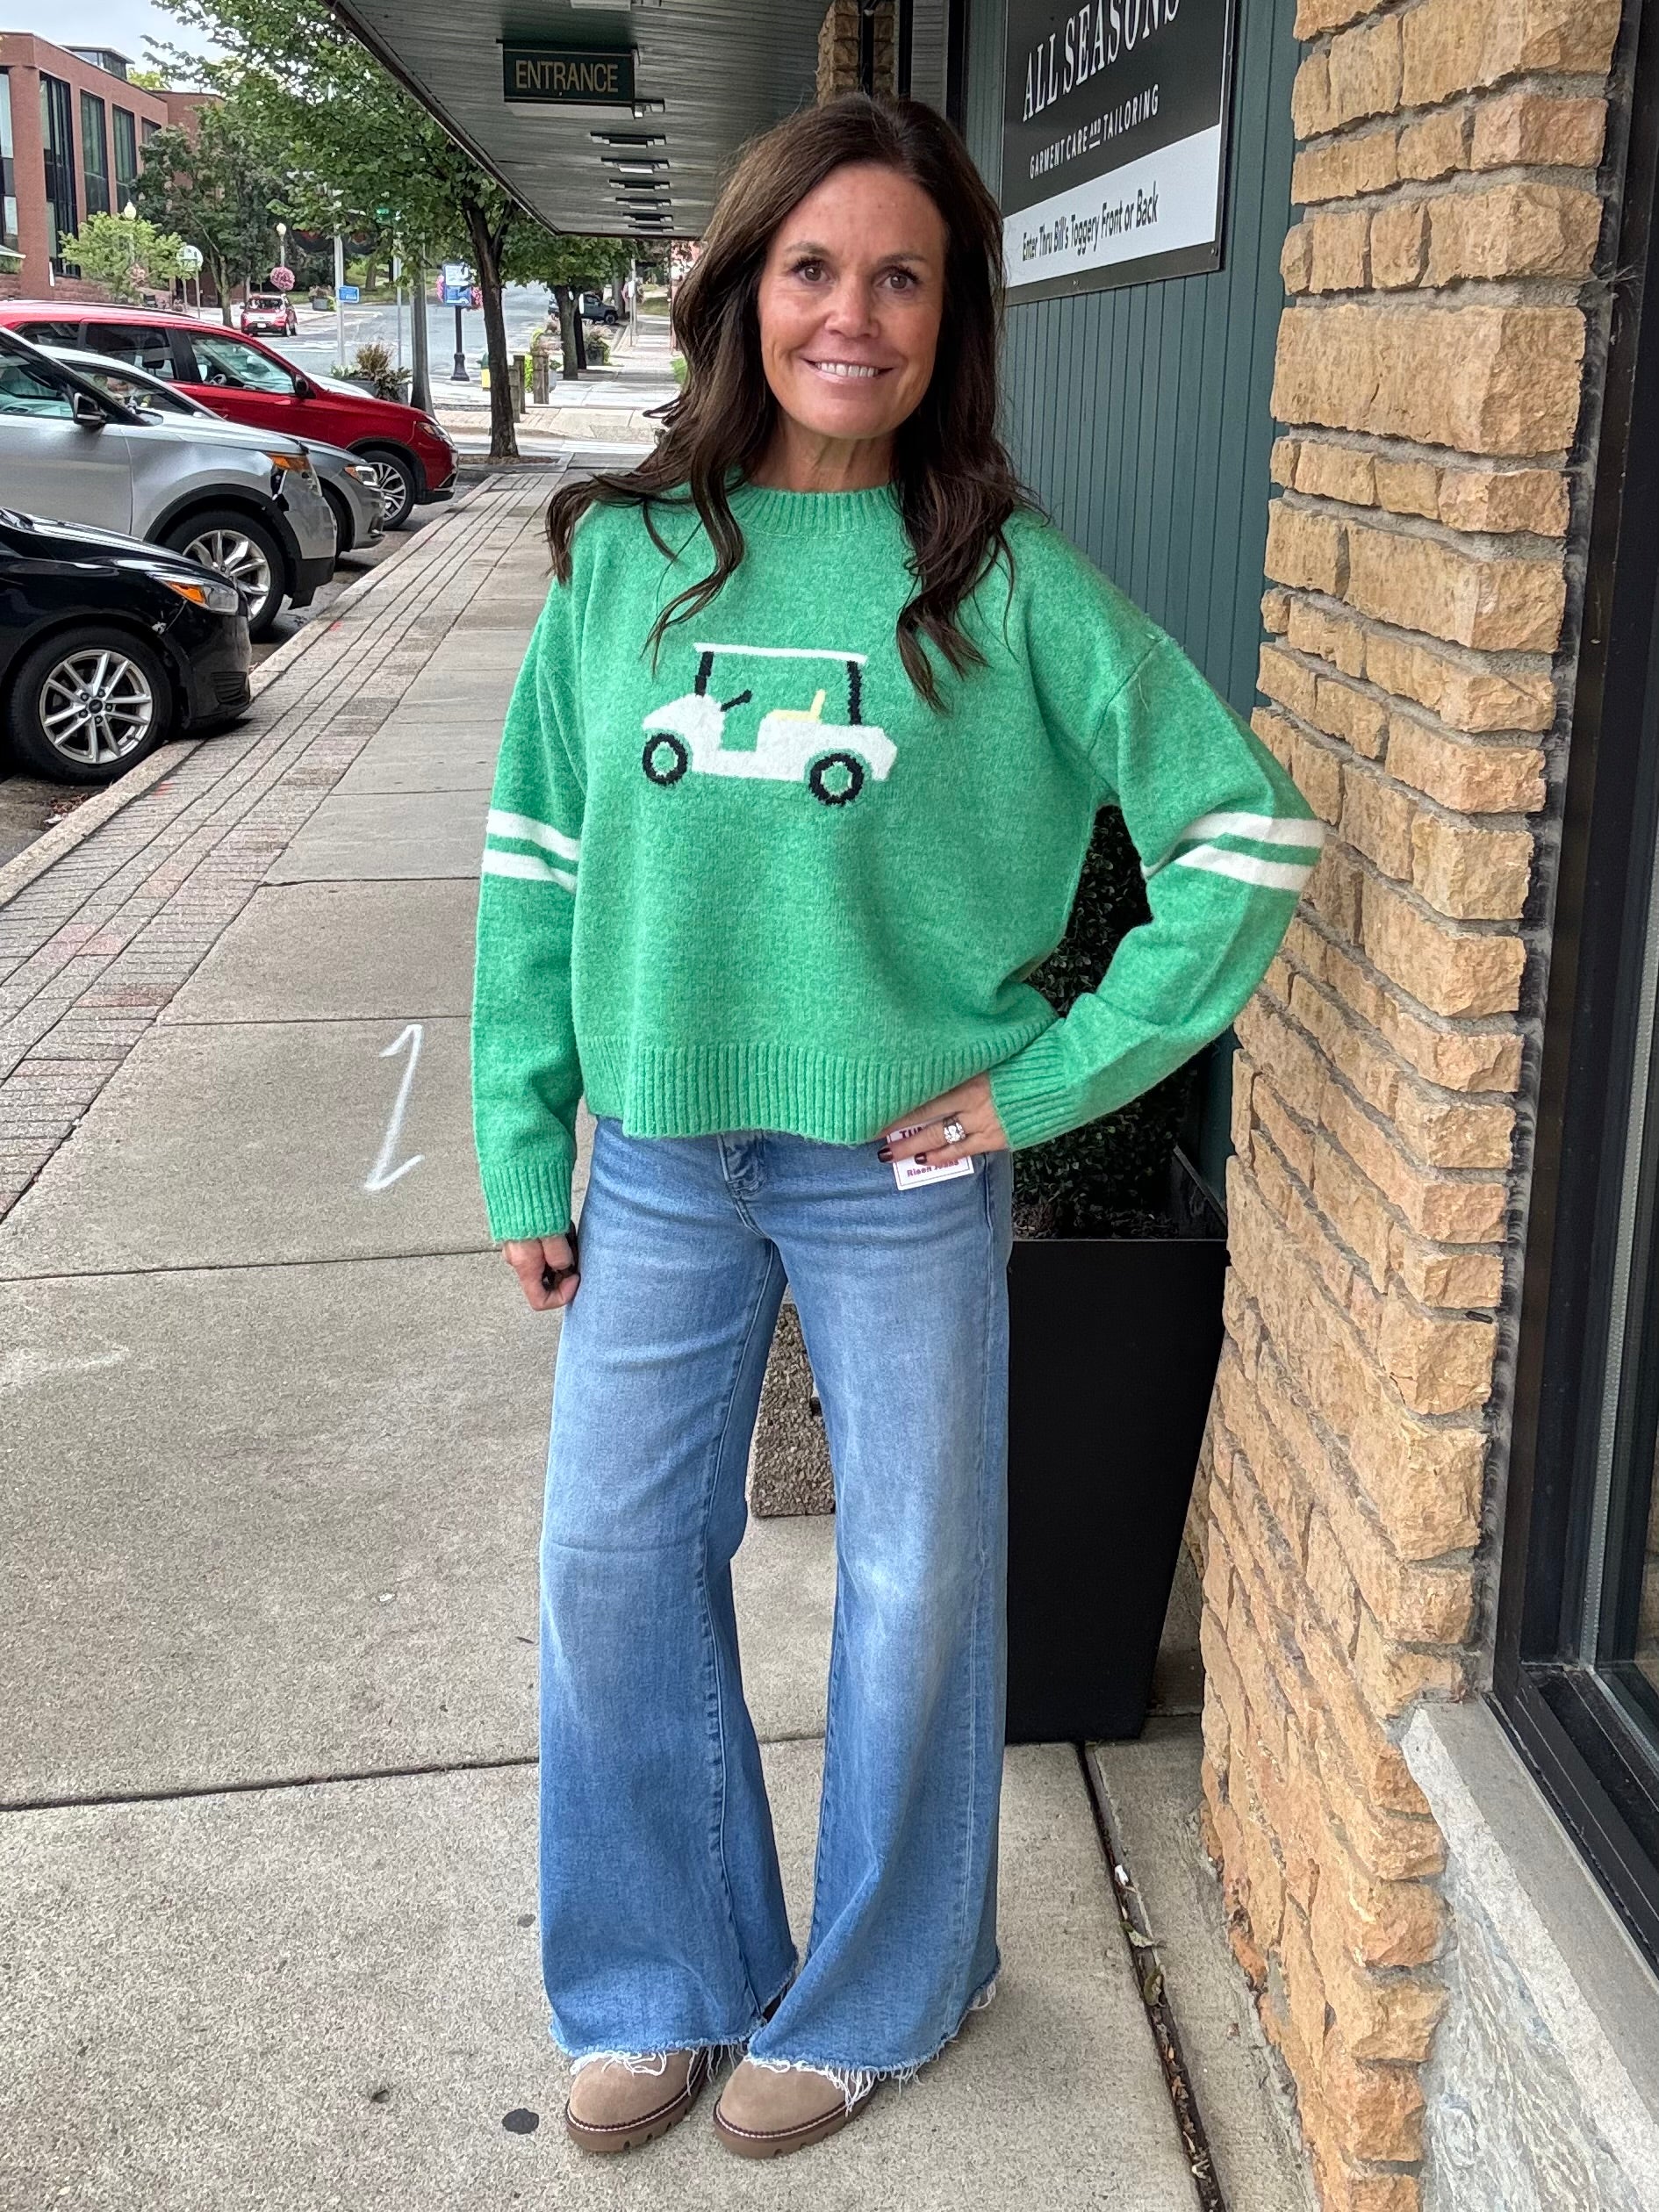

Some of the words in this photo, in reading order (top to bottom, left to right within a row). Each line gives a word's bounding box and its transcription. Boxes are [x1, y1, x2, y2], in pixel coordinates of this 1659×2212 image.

[515, 59, 618, 93] ENTRANCE
[1023, 33, 1059, 122] ALL
[1029, 139, 1066, 180] GARMENT
[1066, 126, 1088, 162] CARE
[1089, 118, 1102, 139] AND
[1102, 83, 1159, 141] TAILORING
[1023, 232, 1038, 262] Enter
[1038, 223, 1053, 257] Thru
[1053, 216, 1069, 253] Bill's
[1071, 213, 1100, 256] Toggery
[1101, 200, 1124, 239] Front
[1124, 202, 1135, 232] or
[1136, 180, 1159, 228] Back
